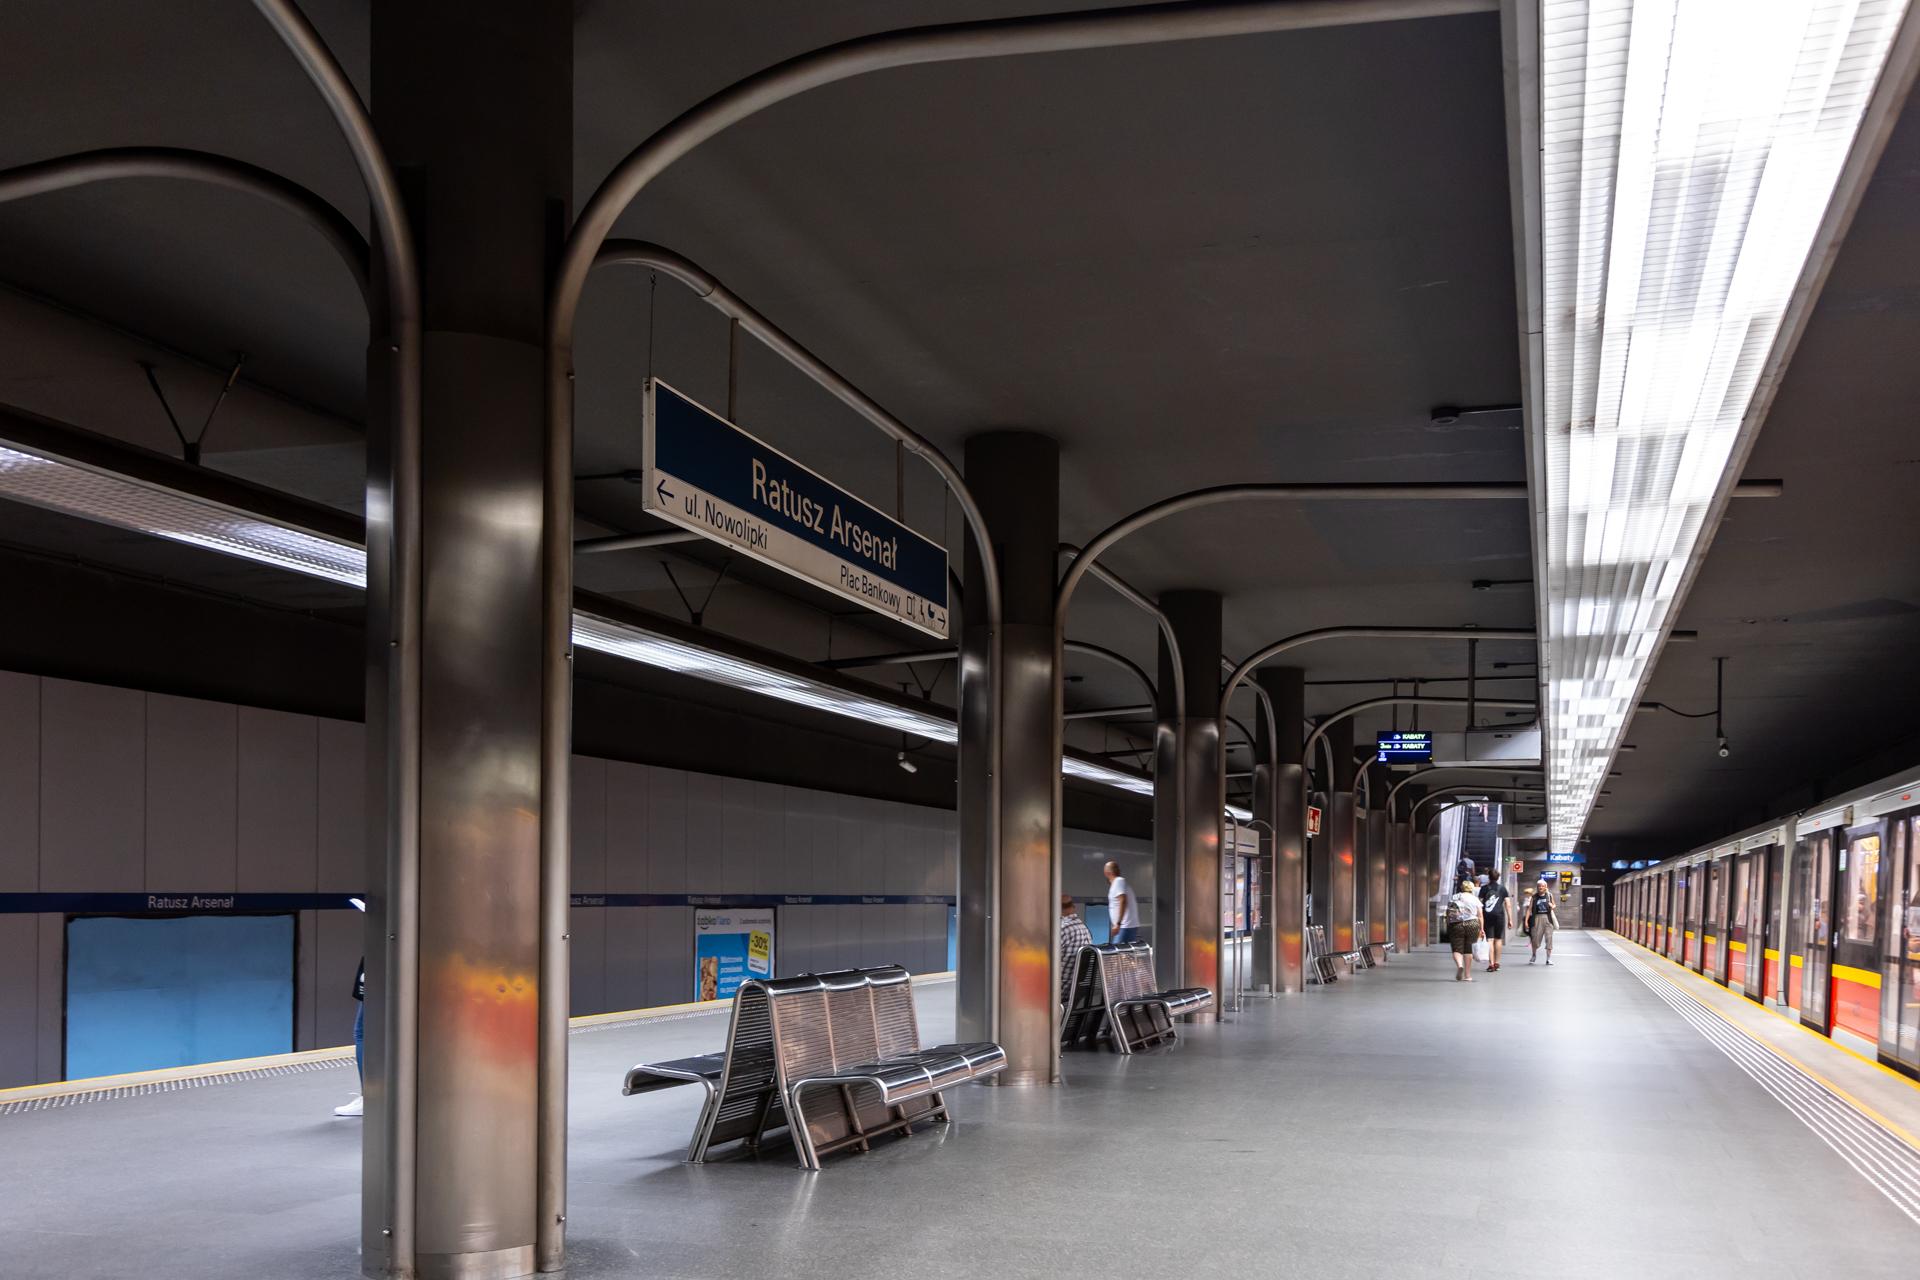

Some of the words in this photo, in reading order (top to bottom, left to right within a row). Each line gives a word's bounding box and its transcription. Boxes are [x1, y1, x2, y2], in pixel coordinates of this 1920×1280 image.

[685, 494, 701, 520] ul.
[705, 500, 768, 550] Nowolipki
[752, 458, 824, 534] Ratusz
[830, 504, 898, 571] Arsenał
[840, 565, 860, 592] Plac
[862, 578, 901, 613] Bankowy
[148, 895, 188, 909] Ratusz
[191, 895, 234, 909] Arsenał
[751, 935, 768, 952] -30%
